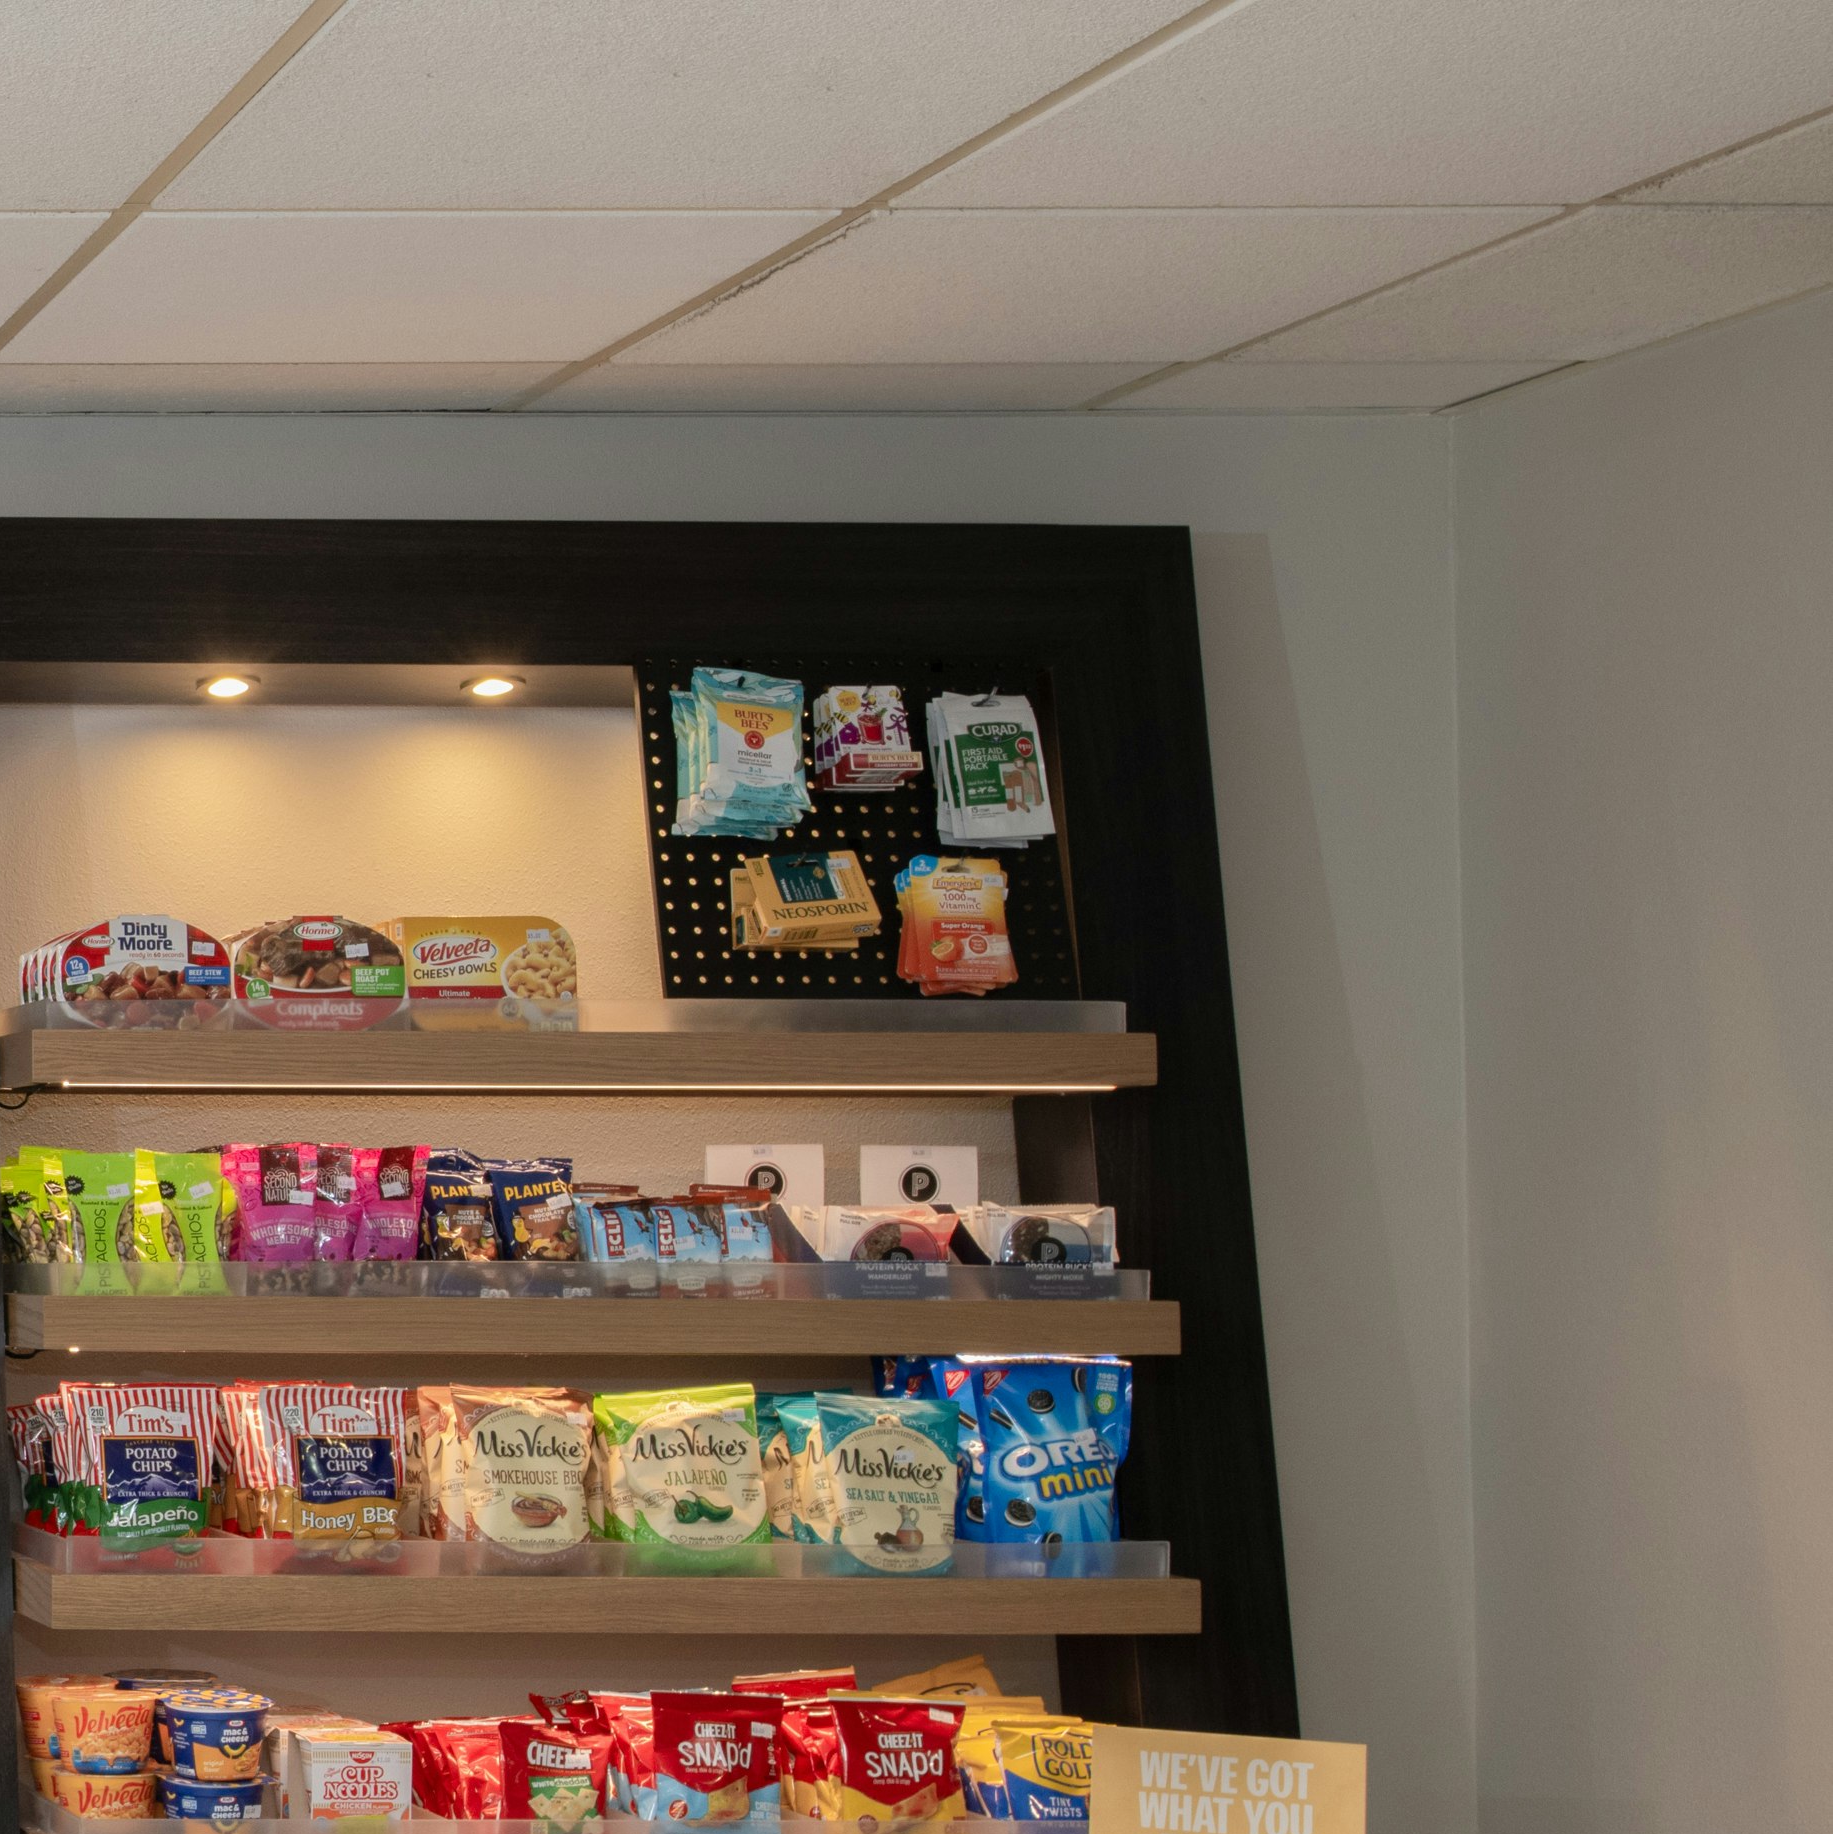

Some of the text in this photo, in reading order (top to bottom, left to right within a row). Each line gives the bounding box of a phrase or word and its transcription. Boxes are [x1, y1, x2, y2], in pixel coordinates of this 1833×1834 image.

[734, 709, 773, 722] BURT'S
[741, 719, 768, 730] BEES
[971, 722, 1018, 738] CURAD
[738, 750, 772, 760] micellar
[961, 748, 982, 757] FIRST
[962, 754, 1009, 764] PORTABLE
[964, 762, 988, 771] PACK
[773, 902, 868, 921] NEOSPORIN
[122, 923, 167, 938] Dinty
[118, 938, 172, 950] Moore
[419, 938, 490, 964] Velveeta
[413, 962, 497, 979] CHEESY BOWLS
[264, 1175, 297, 1188] SECOND
[250, 1226, 317, 1241] WHOLESOME
[267, 1235, 301, 1246] MEDLEY
[94, 1208, 112, 1287] PISTACHIOS
[896, 1263, 920, 1272] PUCK
[124, 1413, 174, 1435] Tim's
[474, 1426, 523, 1459] Miss
[633, 1424, 748, 1467] Miss Vickie's
[125, 1447, 177, 1461] POTATO
[319, 1446, 370, 1460] POTATO
[132, 1459, 173, 1473] CHIPS
[326, 1459, 369, 1473] CHIPS
[884, 1448, 944, 1488] Vickie's
[483, 1469, 558, 1485] SMOKEHOUSE
[664, 1468, 727, 1487] JALAPEÑO
[301, 1508, 353, 1532] Honey
[74, 1705, 151, 1740] Velveeta
[221, 1735, 249, 1743] cheese
[223, 1728, 240, 1736] mac
[694, 1722, 736, 1740] CHEEZ-IT
[877, 1732, 924, 1751] CHEEZ-IT
[678, 1741, 752, 1770] SNAP'd
[864, 1750, 943, 1780] SNAP'd
[341, 1766, 383, 1783] CUP
[1139, 1750, 1315, 1800] WE'VE GOT
[324, 1782, 398, 1799] NOODLES
[1049, 1796, 1072, 1807] TINY
[1138, 1792, 1233, 1834] WHAT
